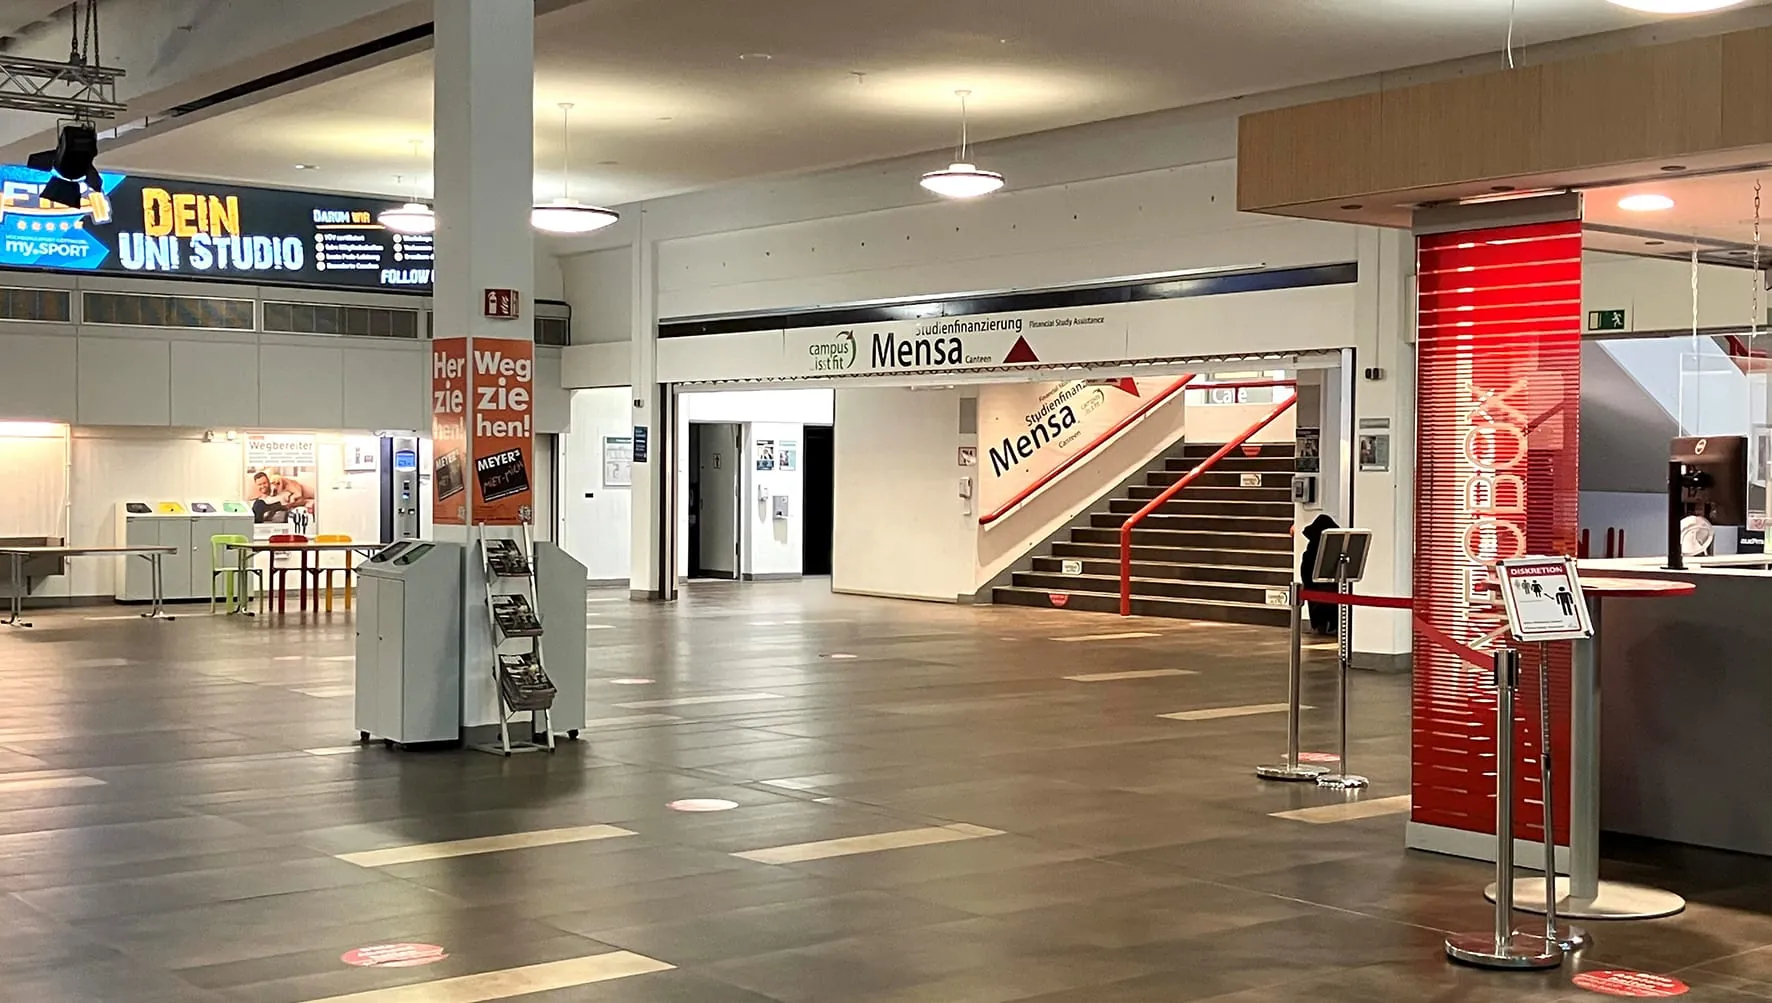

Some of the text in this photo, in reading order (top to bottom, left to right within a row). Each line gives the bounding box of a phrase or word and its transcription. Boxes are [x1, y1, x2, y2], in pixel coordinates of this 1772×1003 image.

[142, 187, 240, 237] DEIN
[313, 208, 371, 223] DARUM WIR
[6, 240, 90, 257] my.SPORT
[118, 232, 304, 270] UNI STUDIO
[381, 269, 430, 284] FOLLOW
[1056, 318, 1072, 327] Study
[809, 343, 849, 358] campus
[872, 332, 992, 369] Mensa Canteen
[434, 351, 465, 379] Her
[474, 350, 532, 382] Weg
[434, 380, 463, 413] zie
[477, 377, 530, 411] zie
[433, 413, 464, 440] hen!
[477, 413, 530, 438] hen!
[249, 441, 313, 452] Wegbereiter
[988, 405, 1076, 478] Mensa
[1510, 566, 1563, 575] DISKRETION
